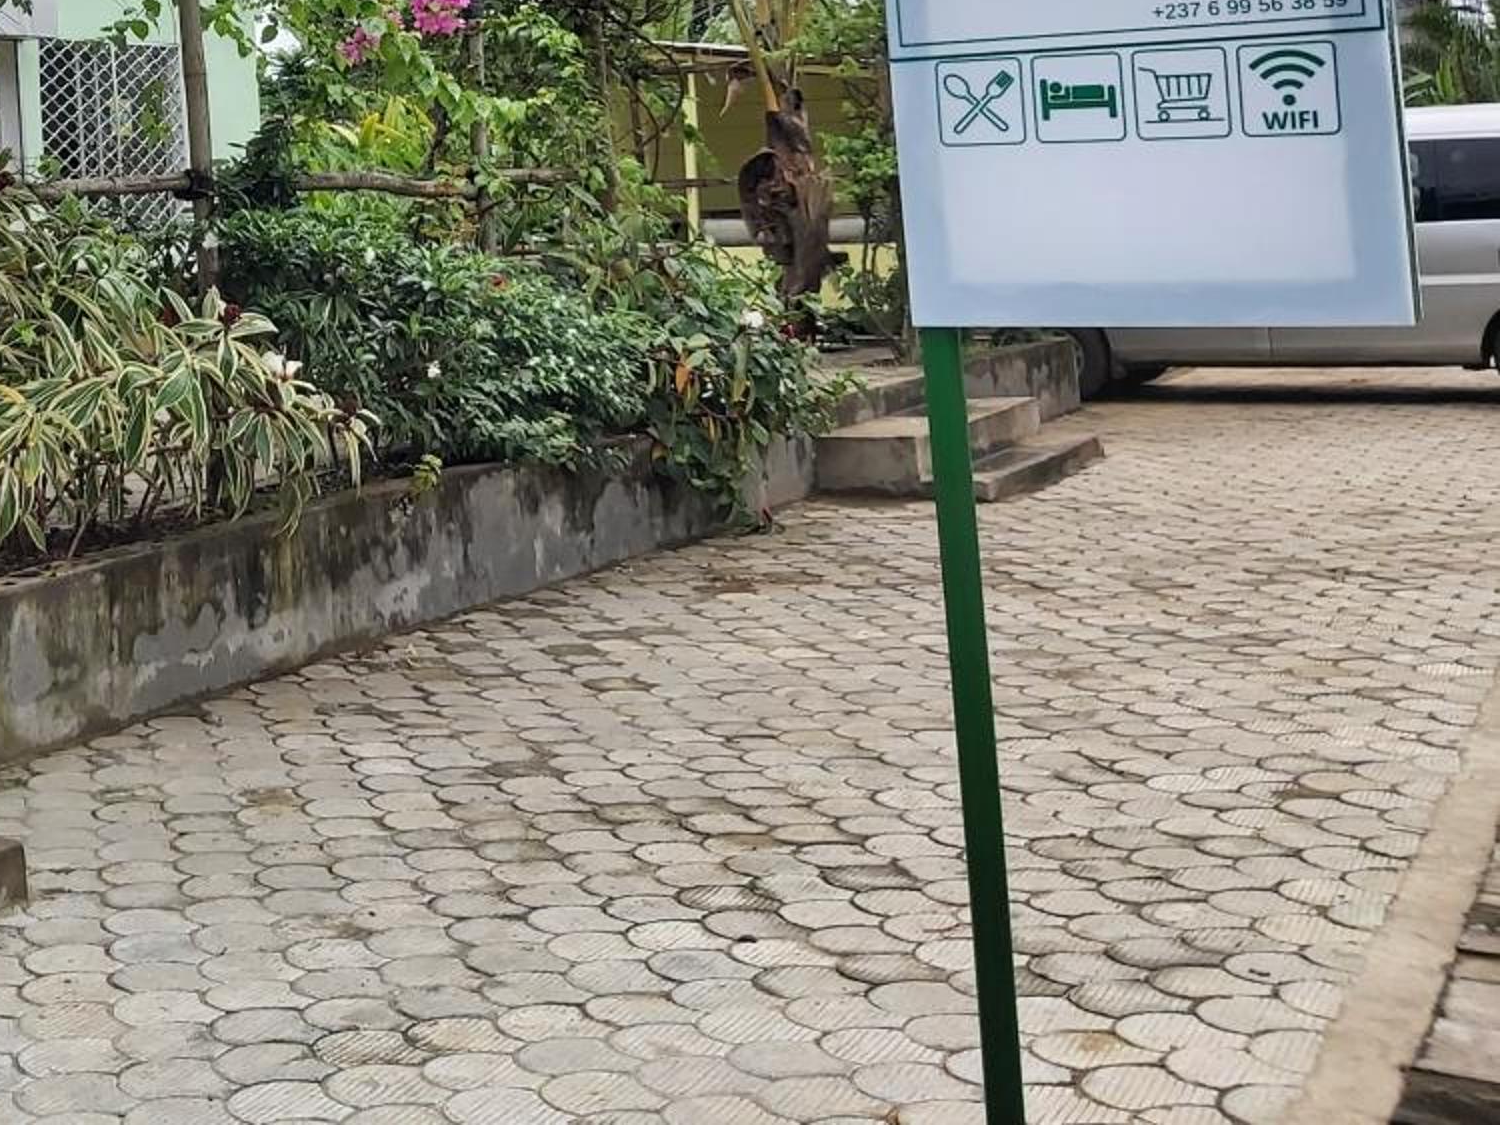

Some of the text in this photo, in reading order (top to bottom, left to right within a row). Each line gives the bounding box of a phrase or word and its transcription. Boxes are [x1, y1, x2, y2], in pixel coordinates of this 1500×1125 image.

[1153, 2, 1201, 19] +237
[1207, 0, 1220, 16] 6
[1262, 110, 1319, 130] WIFI
